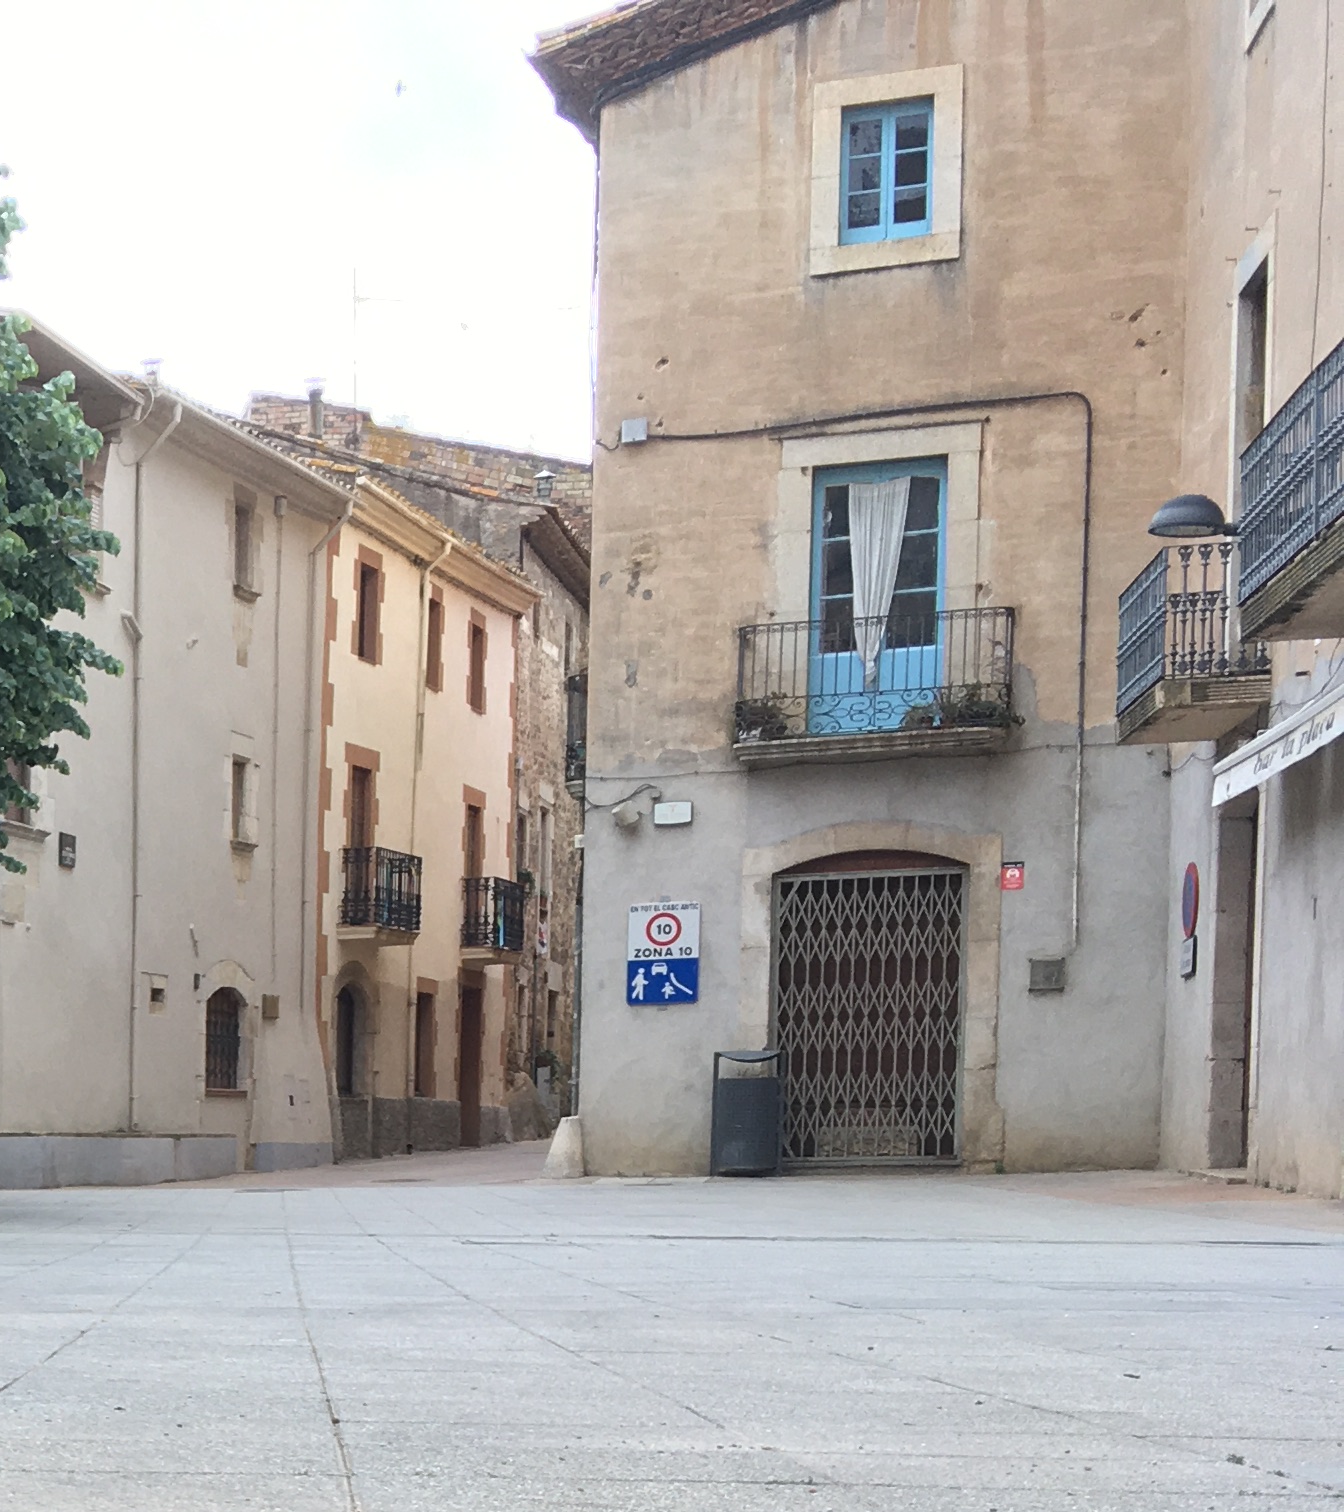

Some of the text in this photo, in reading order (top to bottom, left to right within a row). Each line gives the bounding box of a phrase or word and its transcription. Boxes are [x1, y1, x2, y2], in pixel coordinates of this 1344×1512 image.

[656, 924, 672, 935] 10
[634, 947, 693, 958] ZONA 10
